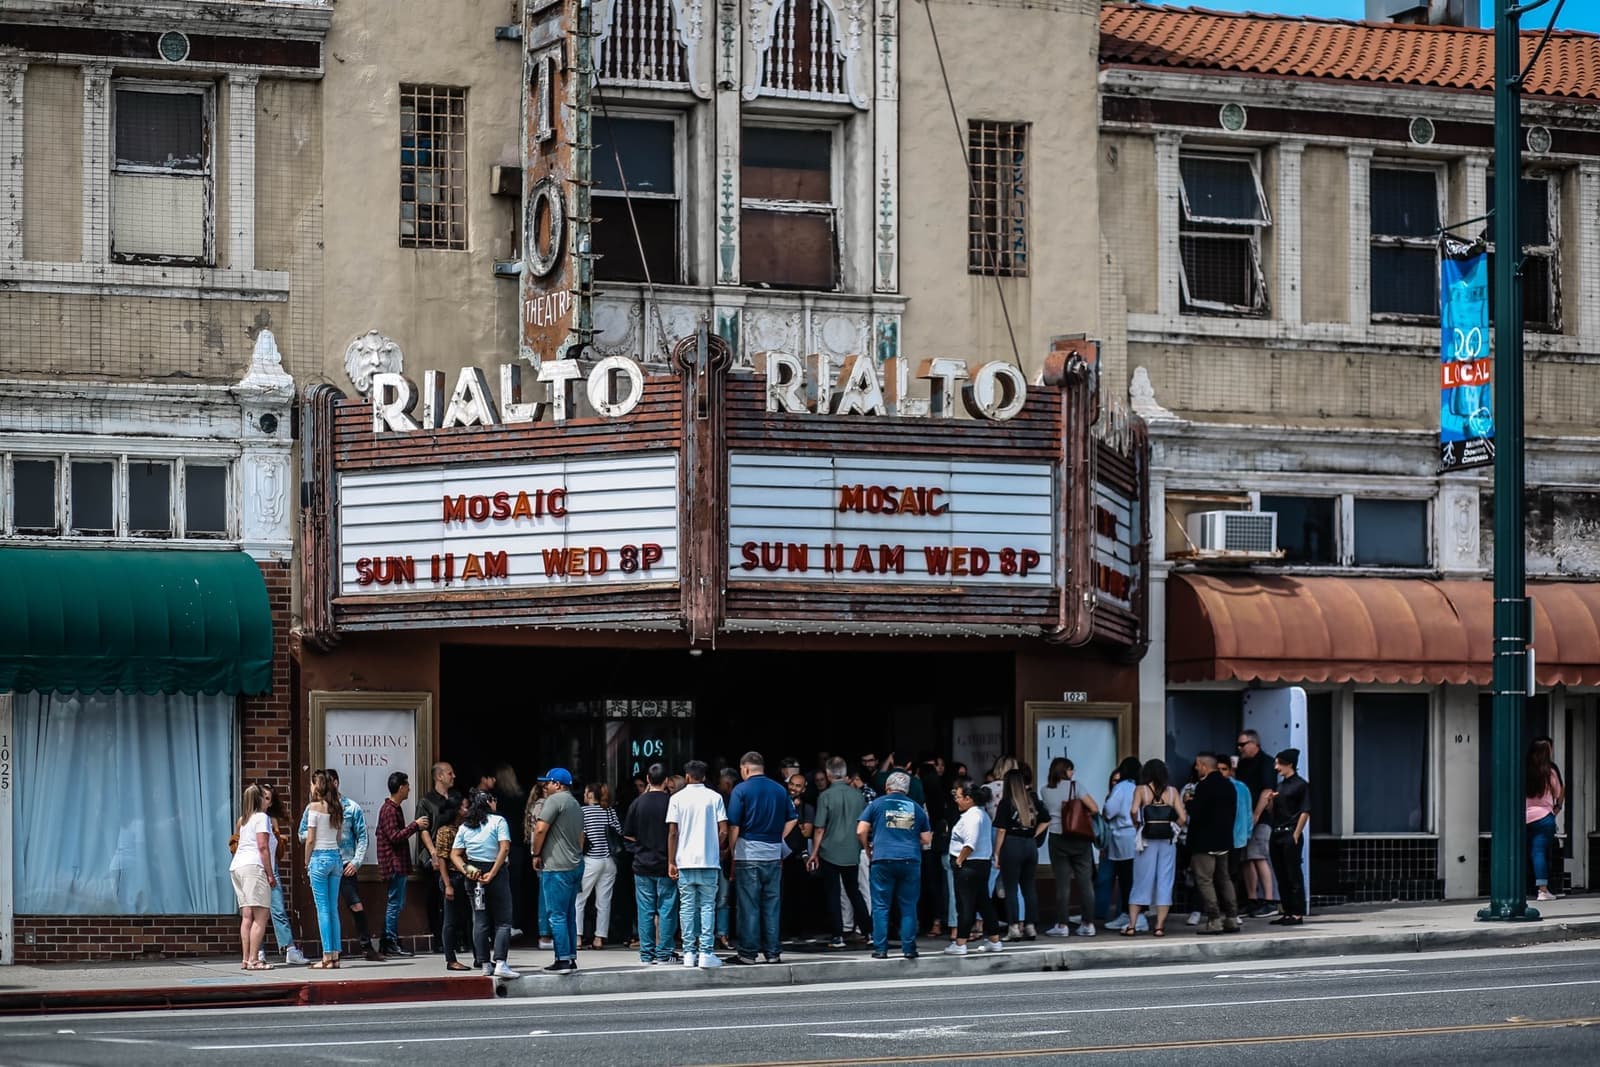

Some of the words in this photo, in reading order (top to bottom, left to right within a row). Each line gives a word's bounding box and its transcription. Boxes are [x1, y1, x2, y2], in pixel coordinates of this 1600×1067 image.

[525, 289, 572, 327] THEATRE
[760, 350, 1028, 423] RIALTO
[1443, 361, 1490, 385] LOCAL
[372, 355, 645, 433] RIALTO
[443, 488, 567, 523] MOSAIC
[838, 484, 947, 516] MOSAIC
[355, 555, 415, 586] SUN
[541, 546, 608, 577] WED
[619, 543, 663, 574] 8P
[740, 541, 808, 571] SUN
[923, 545, 991, 577] WED
[999, 547, 1041, 578] 8P
[1, 735, 10, 790] 1025
[341, 753, 389, 767] TIMES
